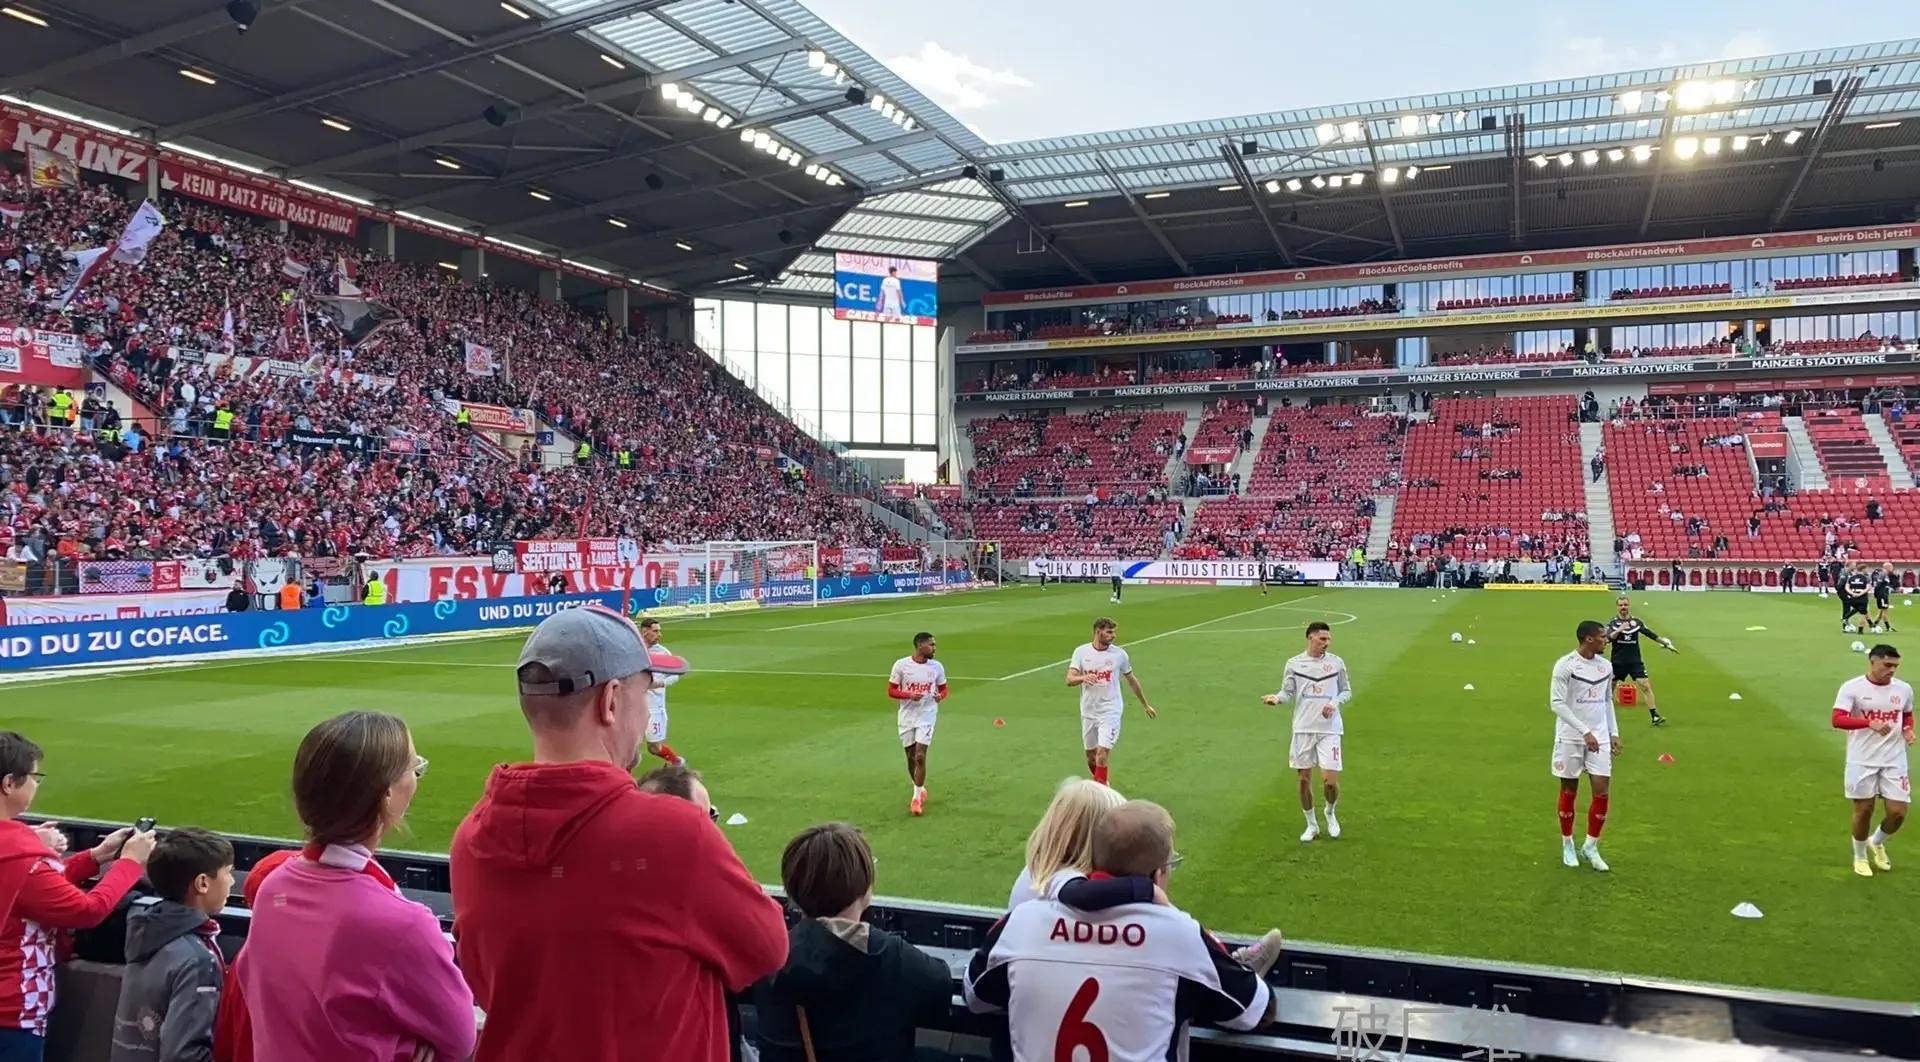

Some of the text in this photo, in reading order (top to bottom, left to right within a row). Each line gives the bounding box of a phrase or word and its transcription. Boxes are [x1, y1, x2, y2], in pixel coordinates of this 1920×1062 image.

[12, 122, 147, 181] MAINZ
[181, 172, 215, 198] KEIN
[220, 183, 257, 209] PLATZ
[260, 194, 286, 217] FÜR
[1816, 228, 1913, 244] Bewirb Dich jetzt!
[1586, 244, 1685, 260] #BockAufHandwerk
[1359, 260, 1464, 276] #BockAufCooleBenefits
[1573, 362, 1694, 376] MAINZER STADTWERKE
[1752, 354, 1886, 368] MAINZER STADTWERKE
[1255, 377, 1359, 390] MAINZER STADTWERKE
[1408, 370, 1520, 383] MAINZER STADTWERKE
[986, 390, 1074, 401] MAINZER STADTWERKE
[1115, 384, 1210, 396] MAINZER STADTWERKE
[522, 552, 565, 571] SEKTION
[1165, 563, 1297, 577] INDUSTRIEBDN
[907, 578, 914, 586] DU
[760, 586, 770, 598] DU
[771, 586, 782, 597] ZU
[783, 584, 812, 596] COFACE.
[479, 606, 510, 621] UND
[513, 604, 533, 617] DU
[536, 601, 553, 616] ZU
[40, 633, 80, 655] DU
[88, 629, 122, 651] ZU
[130, 624, 229, 648] COFACE.
[1050, 917, 1146, 947] ADDO
[1054, 976, 1109, 1062] 6
